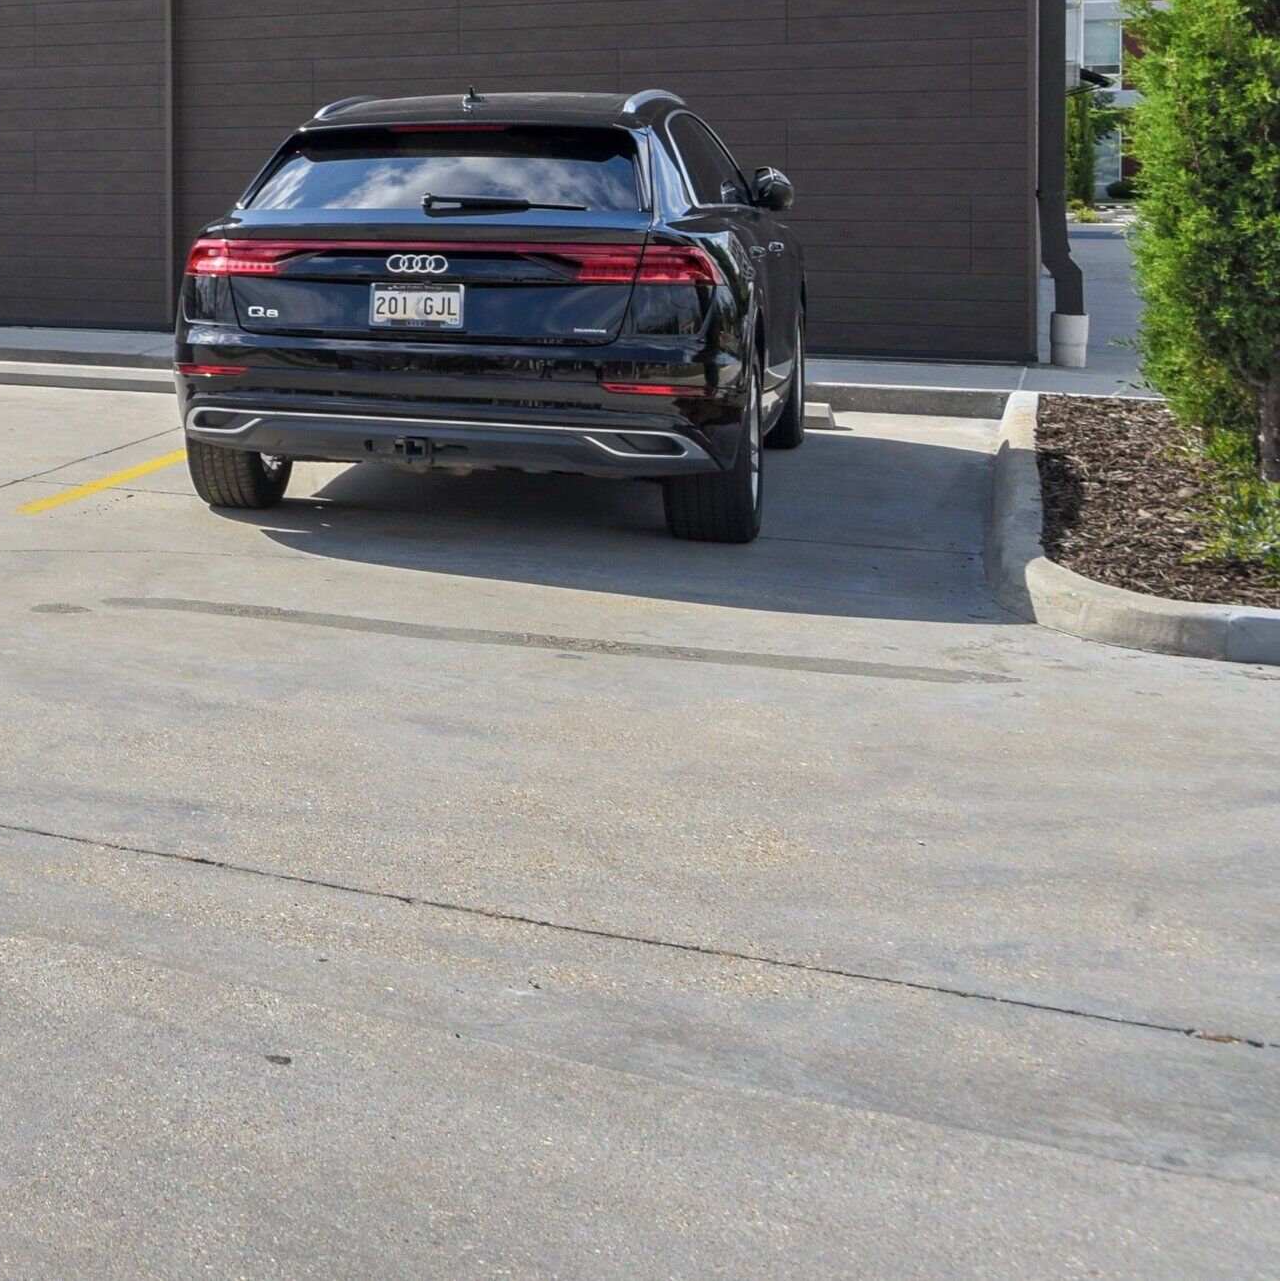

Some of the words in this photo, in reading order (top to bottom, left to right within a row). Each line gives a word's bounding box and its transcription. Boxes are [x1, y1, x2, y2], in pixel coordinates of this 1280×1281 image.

[248, 306, 279, 318] Q8
[376, 296, 407, 315] 201
[424, 297, 457, 315] GJL
